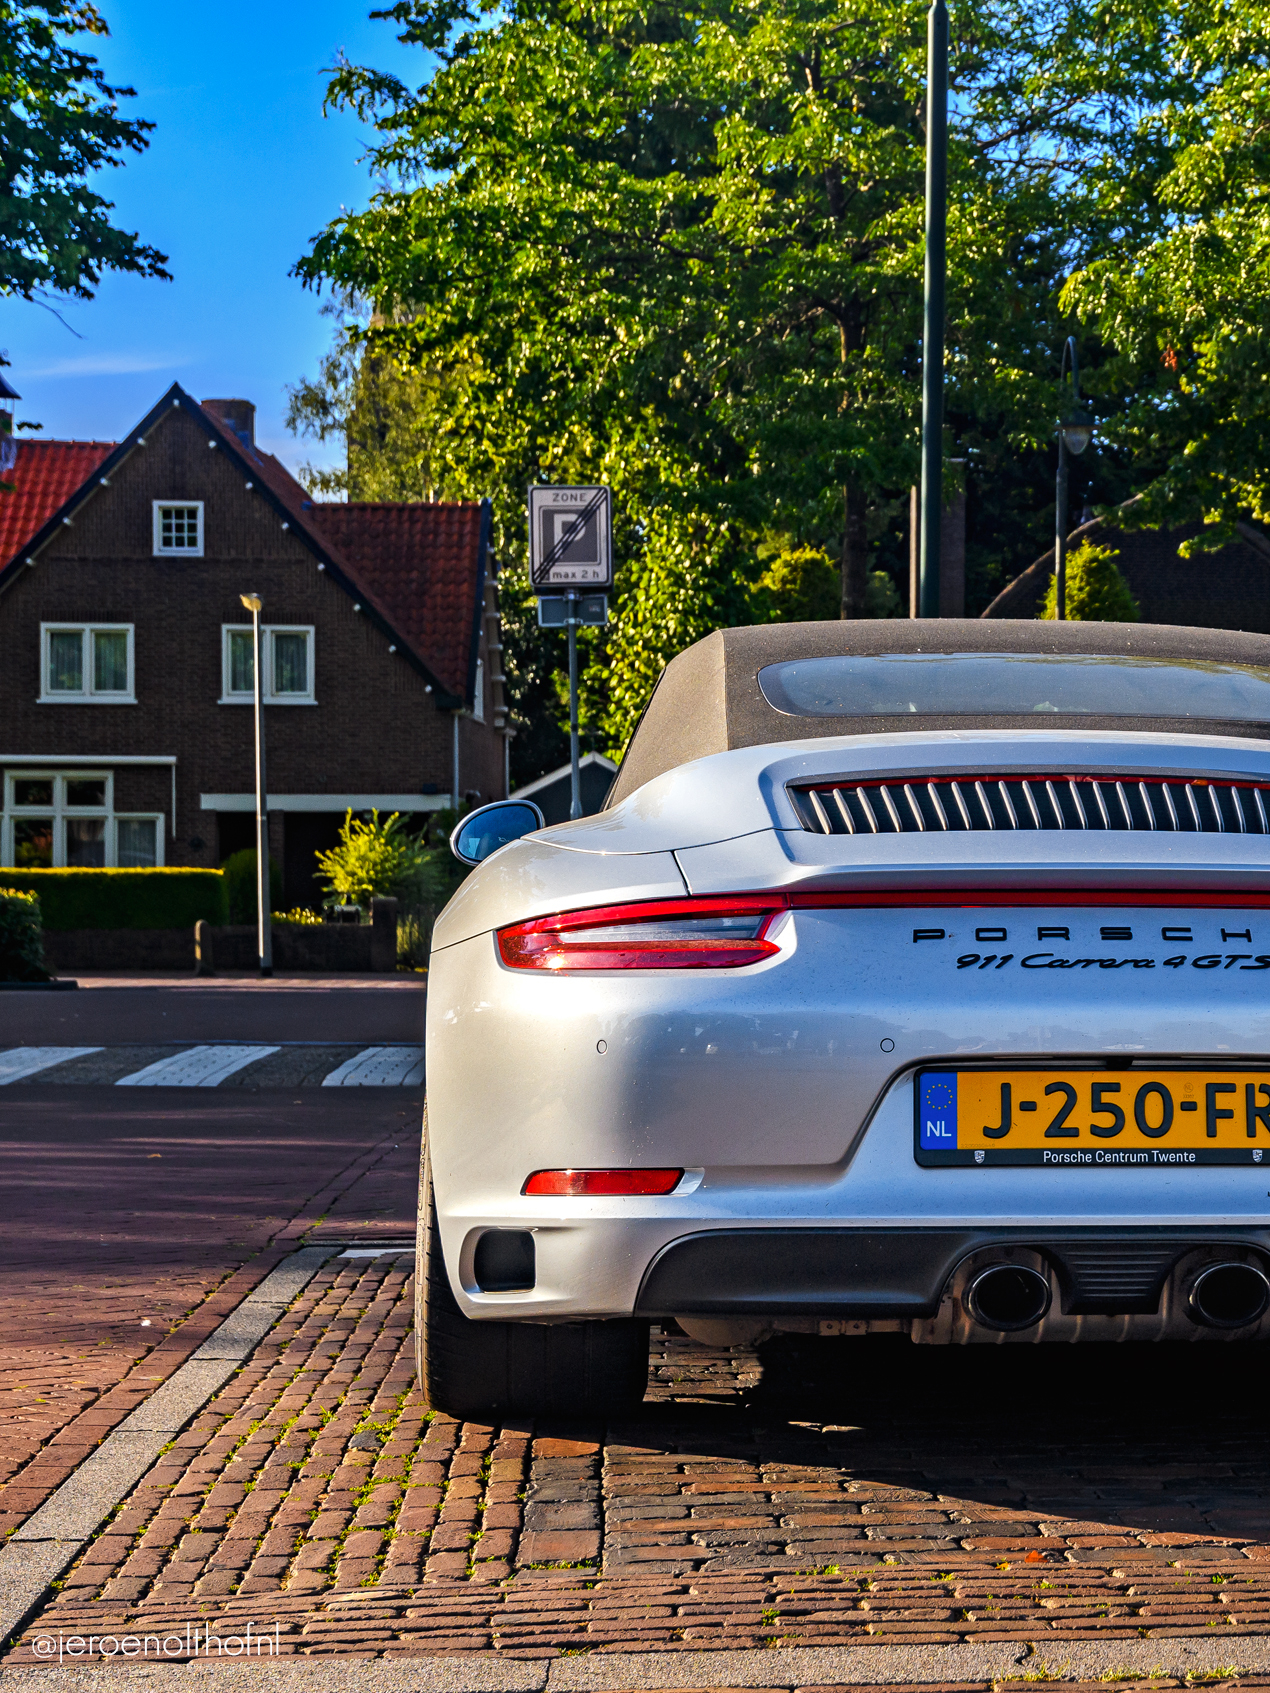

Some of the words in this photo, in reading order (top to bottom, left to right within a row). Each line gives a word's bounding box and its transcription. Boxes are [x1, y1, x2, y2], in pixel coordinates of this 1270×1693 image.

[552, 492, 587, 502] ZONE
[552, 570, 577, 579] max
[581, 569, 589, 578] 2
[592, 569, 599, 578] h
[956, 953, 1014, 970] 911
[1020, 952, 1156, 970] Carrera
[926, 1120, 952, 1137] NL
[1043, 1149, 1094, 1163] Porsche
[1095, 1149, 1149, 1163] Centrum
[1151, 1149, 1196, 1163] Twente
